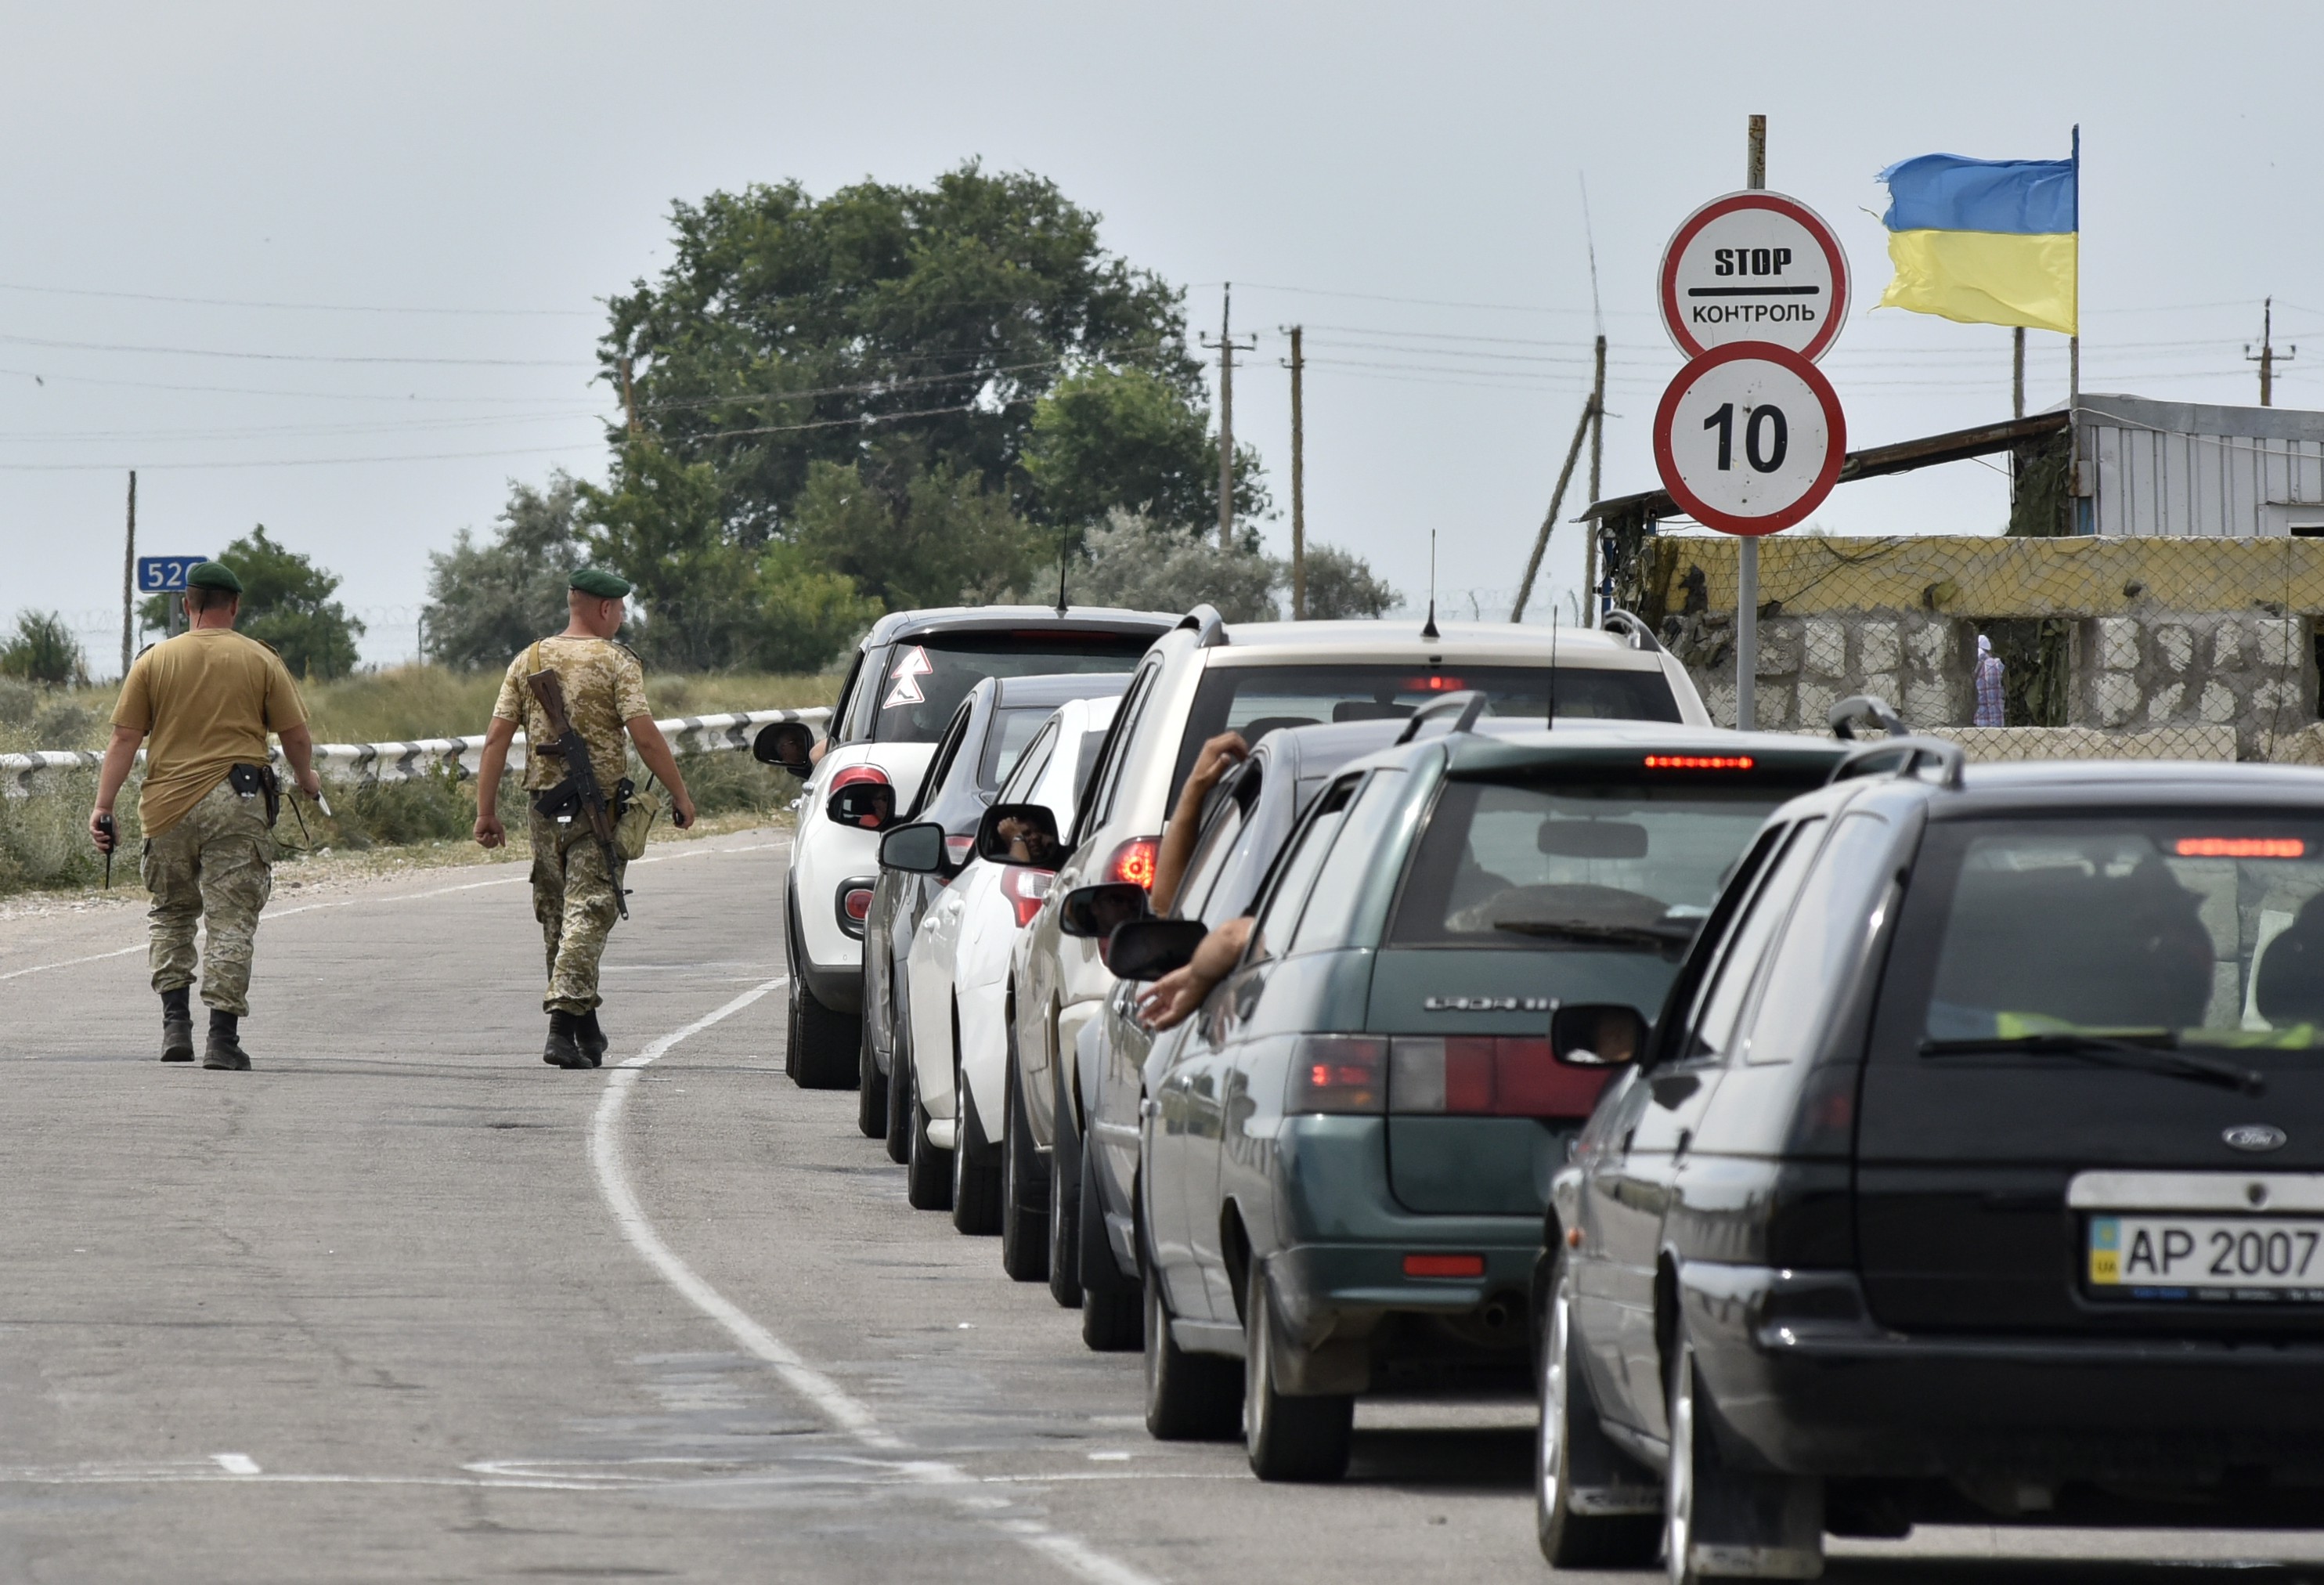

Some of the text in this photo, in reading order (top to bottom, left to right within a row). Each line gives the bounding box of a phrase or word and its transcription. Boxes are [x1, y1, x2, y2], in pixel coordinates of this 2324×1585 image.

[1715, 247, 1792, 276] STOP
[1692, 304, 1816, 323] КОНТРОЛЬ
[1703, 402, 1788, 473] 10
[2127, 1228, 2321, 1276] AP 2007
